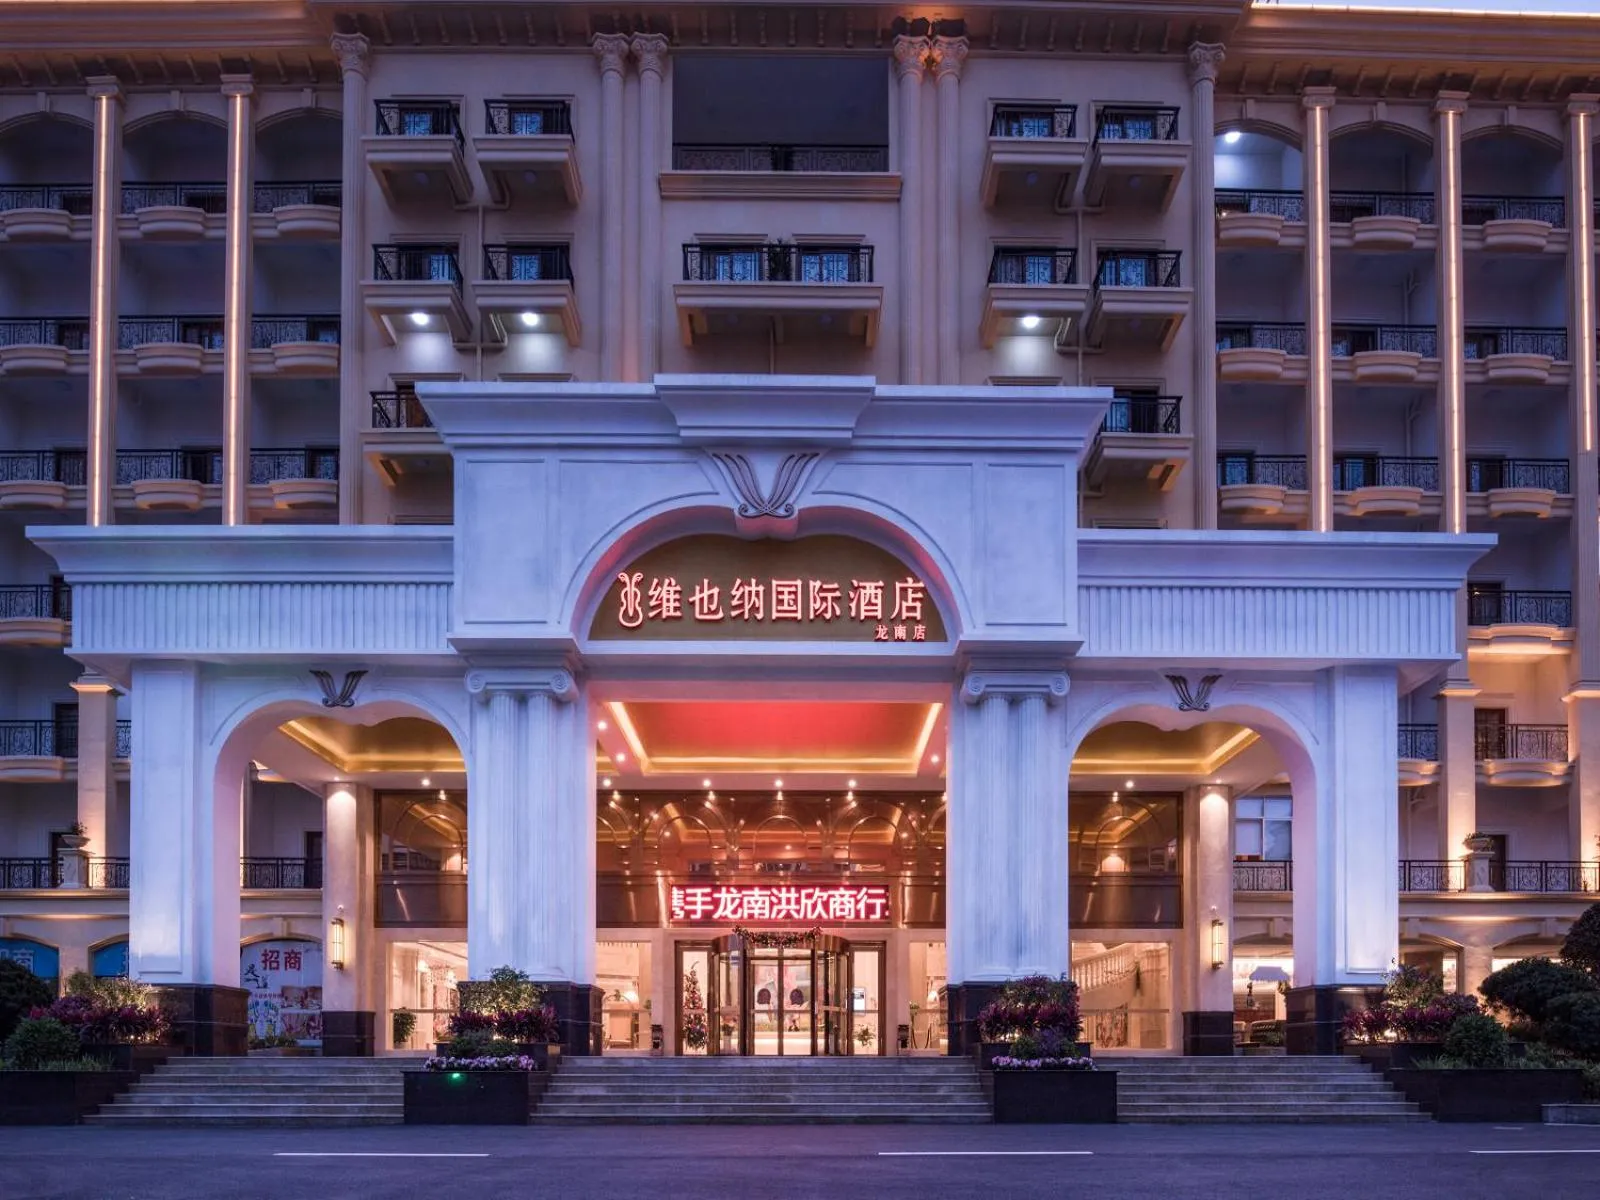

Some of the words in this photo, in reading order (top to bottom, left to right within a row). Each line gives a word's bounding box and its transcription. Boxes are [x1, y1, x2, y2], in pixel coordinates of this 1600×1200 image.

[647, 577, 926, 622] 维也纳国际酒店
[873, 624, 927, 641] 龙南店
[261, 949, 303, 971] 招商
